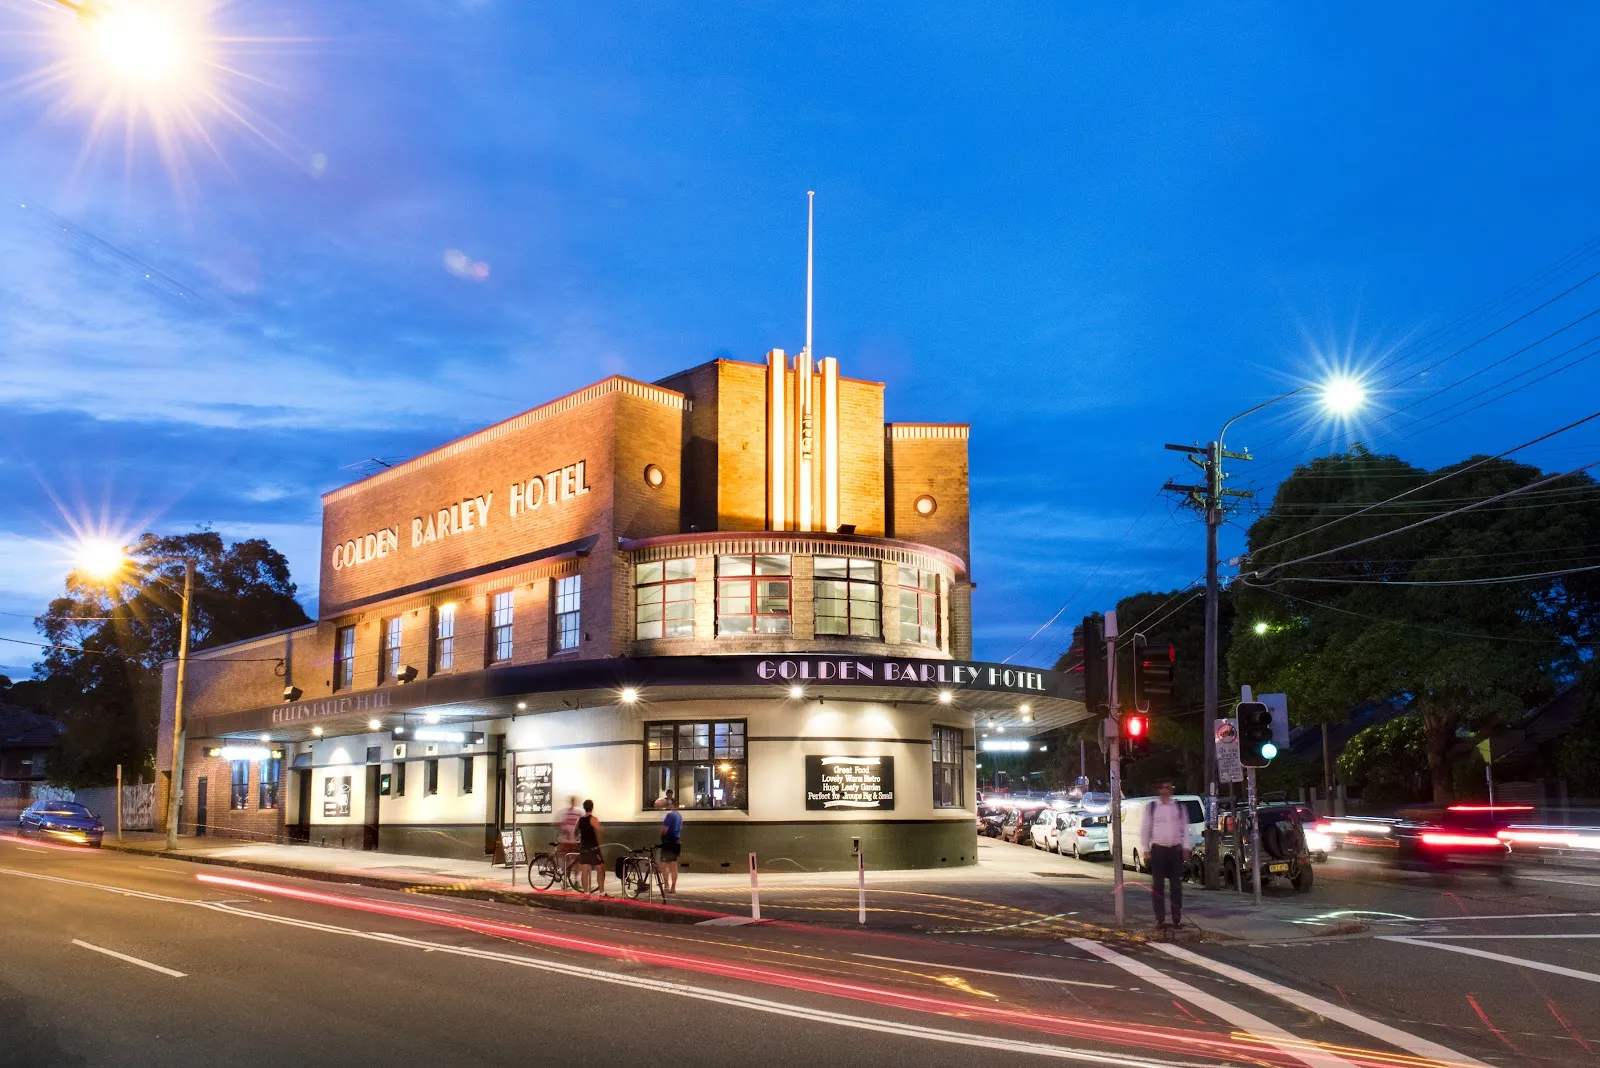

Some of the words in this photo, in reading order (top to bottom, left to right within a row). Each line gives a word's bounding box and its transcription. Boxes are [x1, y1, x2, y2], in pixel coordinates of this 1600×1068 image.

[332, 524, 399, 570] GOLDEN
[411, 491, 493, 548] BARLEY
[509, 460, 590, 517] HOTEL
[757, 660, 874, 680] GOLDEN
[884, 662, 982, 684] BARLEY
[988, 667, 1046, 691] HOTEL
[833, 765, 852, 774] Great
[854, 765, 870, 774] Food
[821, 774, 844, 784] Lovely
[822, 783, 840, 792] Huge
[841, 783, 860, 792] Leafy
[860, 783, 881, 791] Garden
[807, 792, 831, 800] Perfect
[832, 791, 841, 800] for
[873, 792, 878, 800] &
[878, 791, 893, 800] Small
